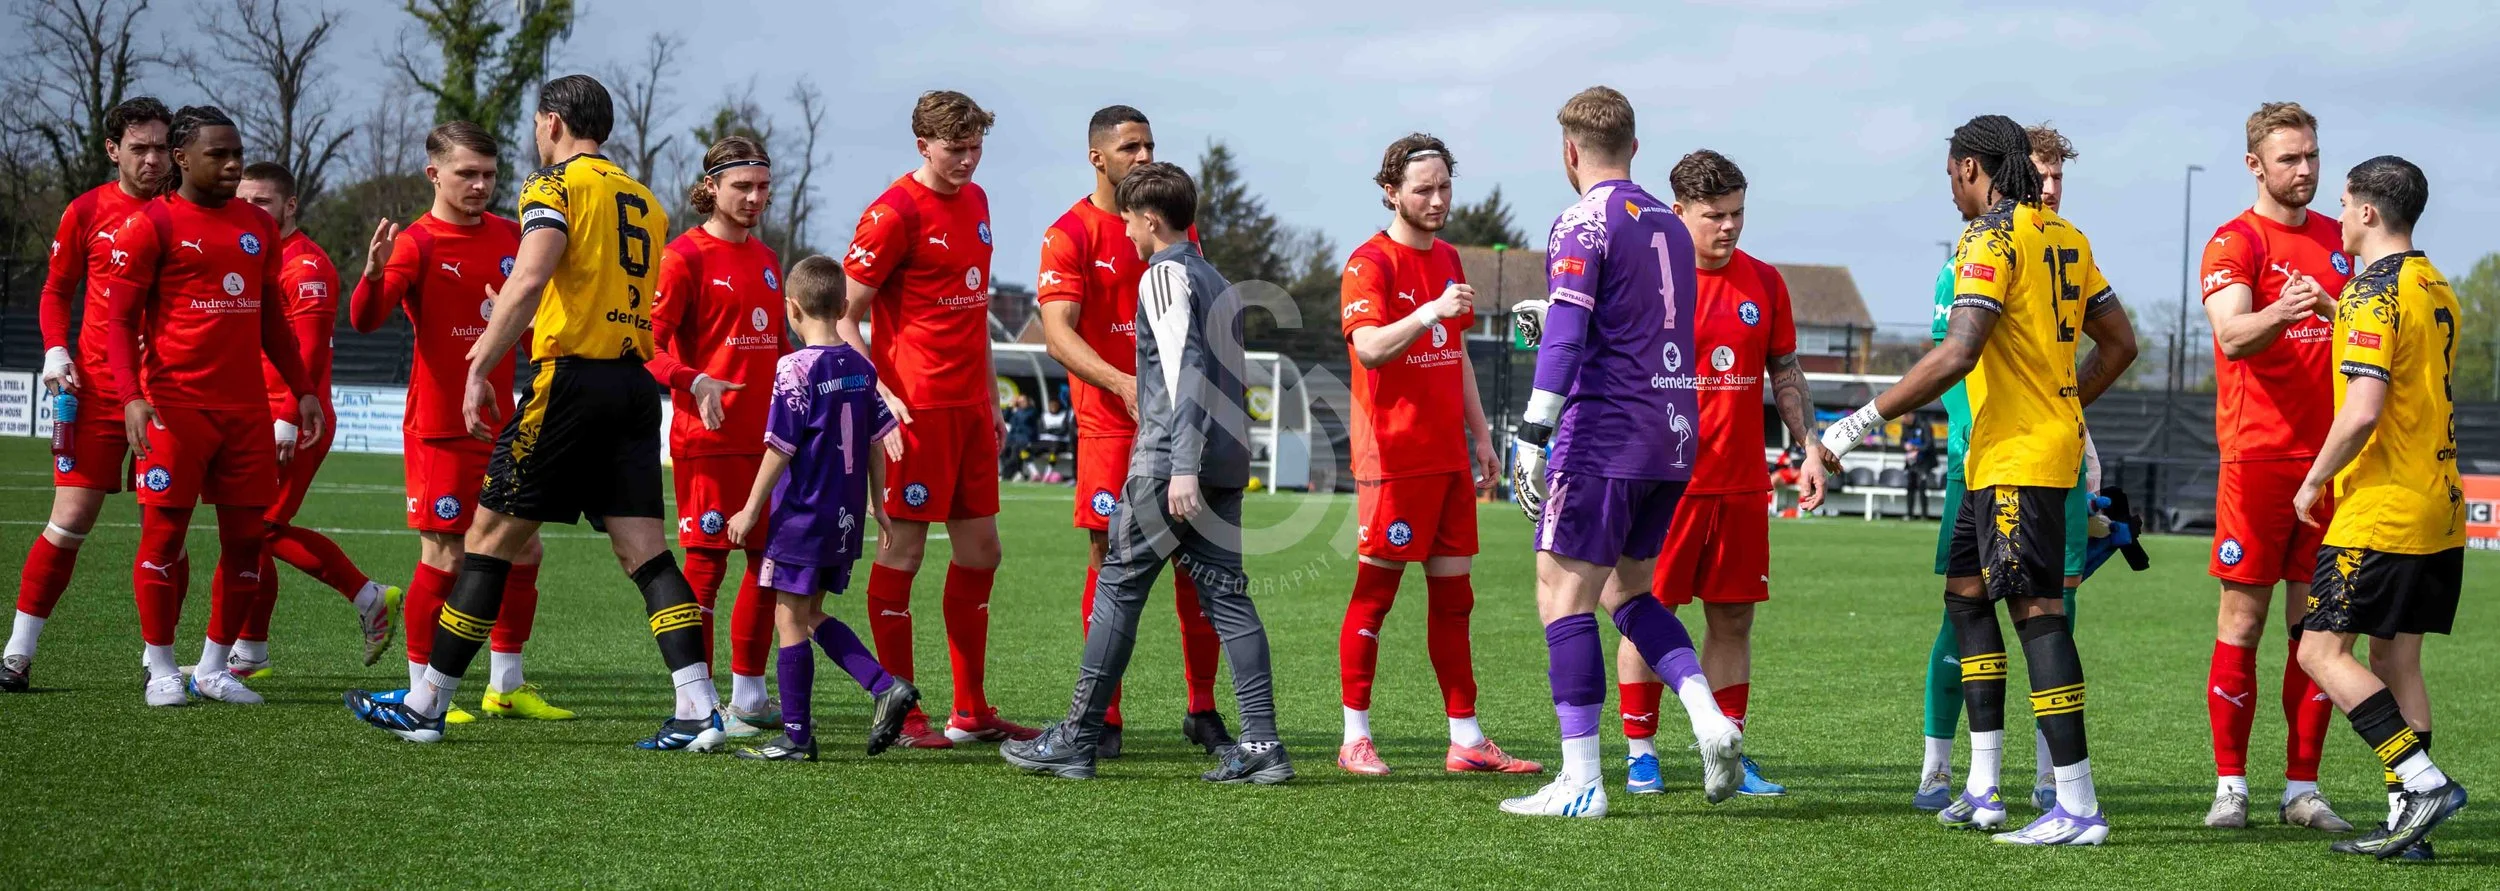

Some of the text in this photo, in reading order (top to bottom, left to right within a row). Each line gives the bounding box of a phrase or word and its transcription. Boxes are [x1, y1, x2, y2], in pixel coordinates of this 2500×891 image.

[614, 191, 651, 278] 6
[1650, 231, 1677, 329] 1
[2203, 269, 2233, 292] DMC
[936, 294, 975, 306] Andrew
[2043, 245, 2081, 343] 15
[190, 298, 235, 309] Andrew
[2285, 326, 2328, 339] Andrew
[725, 335, 760, 347] Andrew
[2353, 366, 2383, 378] FOOTBALL
[1651, 372, 1698, 390] demelza
[1723, 373, 1758, 385] Skinner
[4, 380, 20, 391] STEEL
[5, 407, 22, 418] HOUSE
[836, 401, 854, 475] 1
